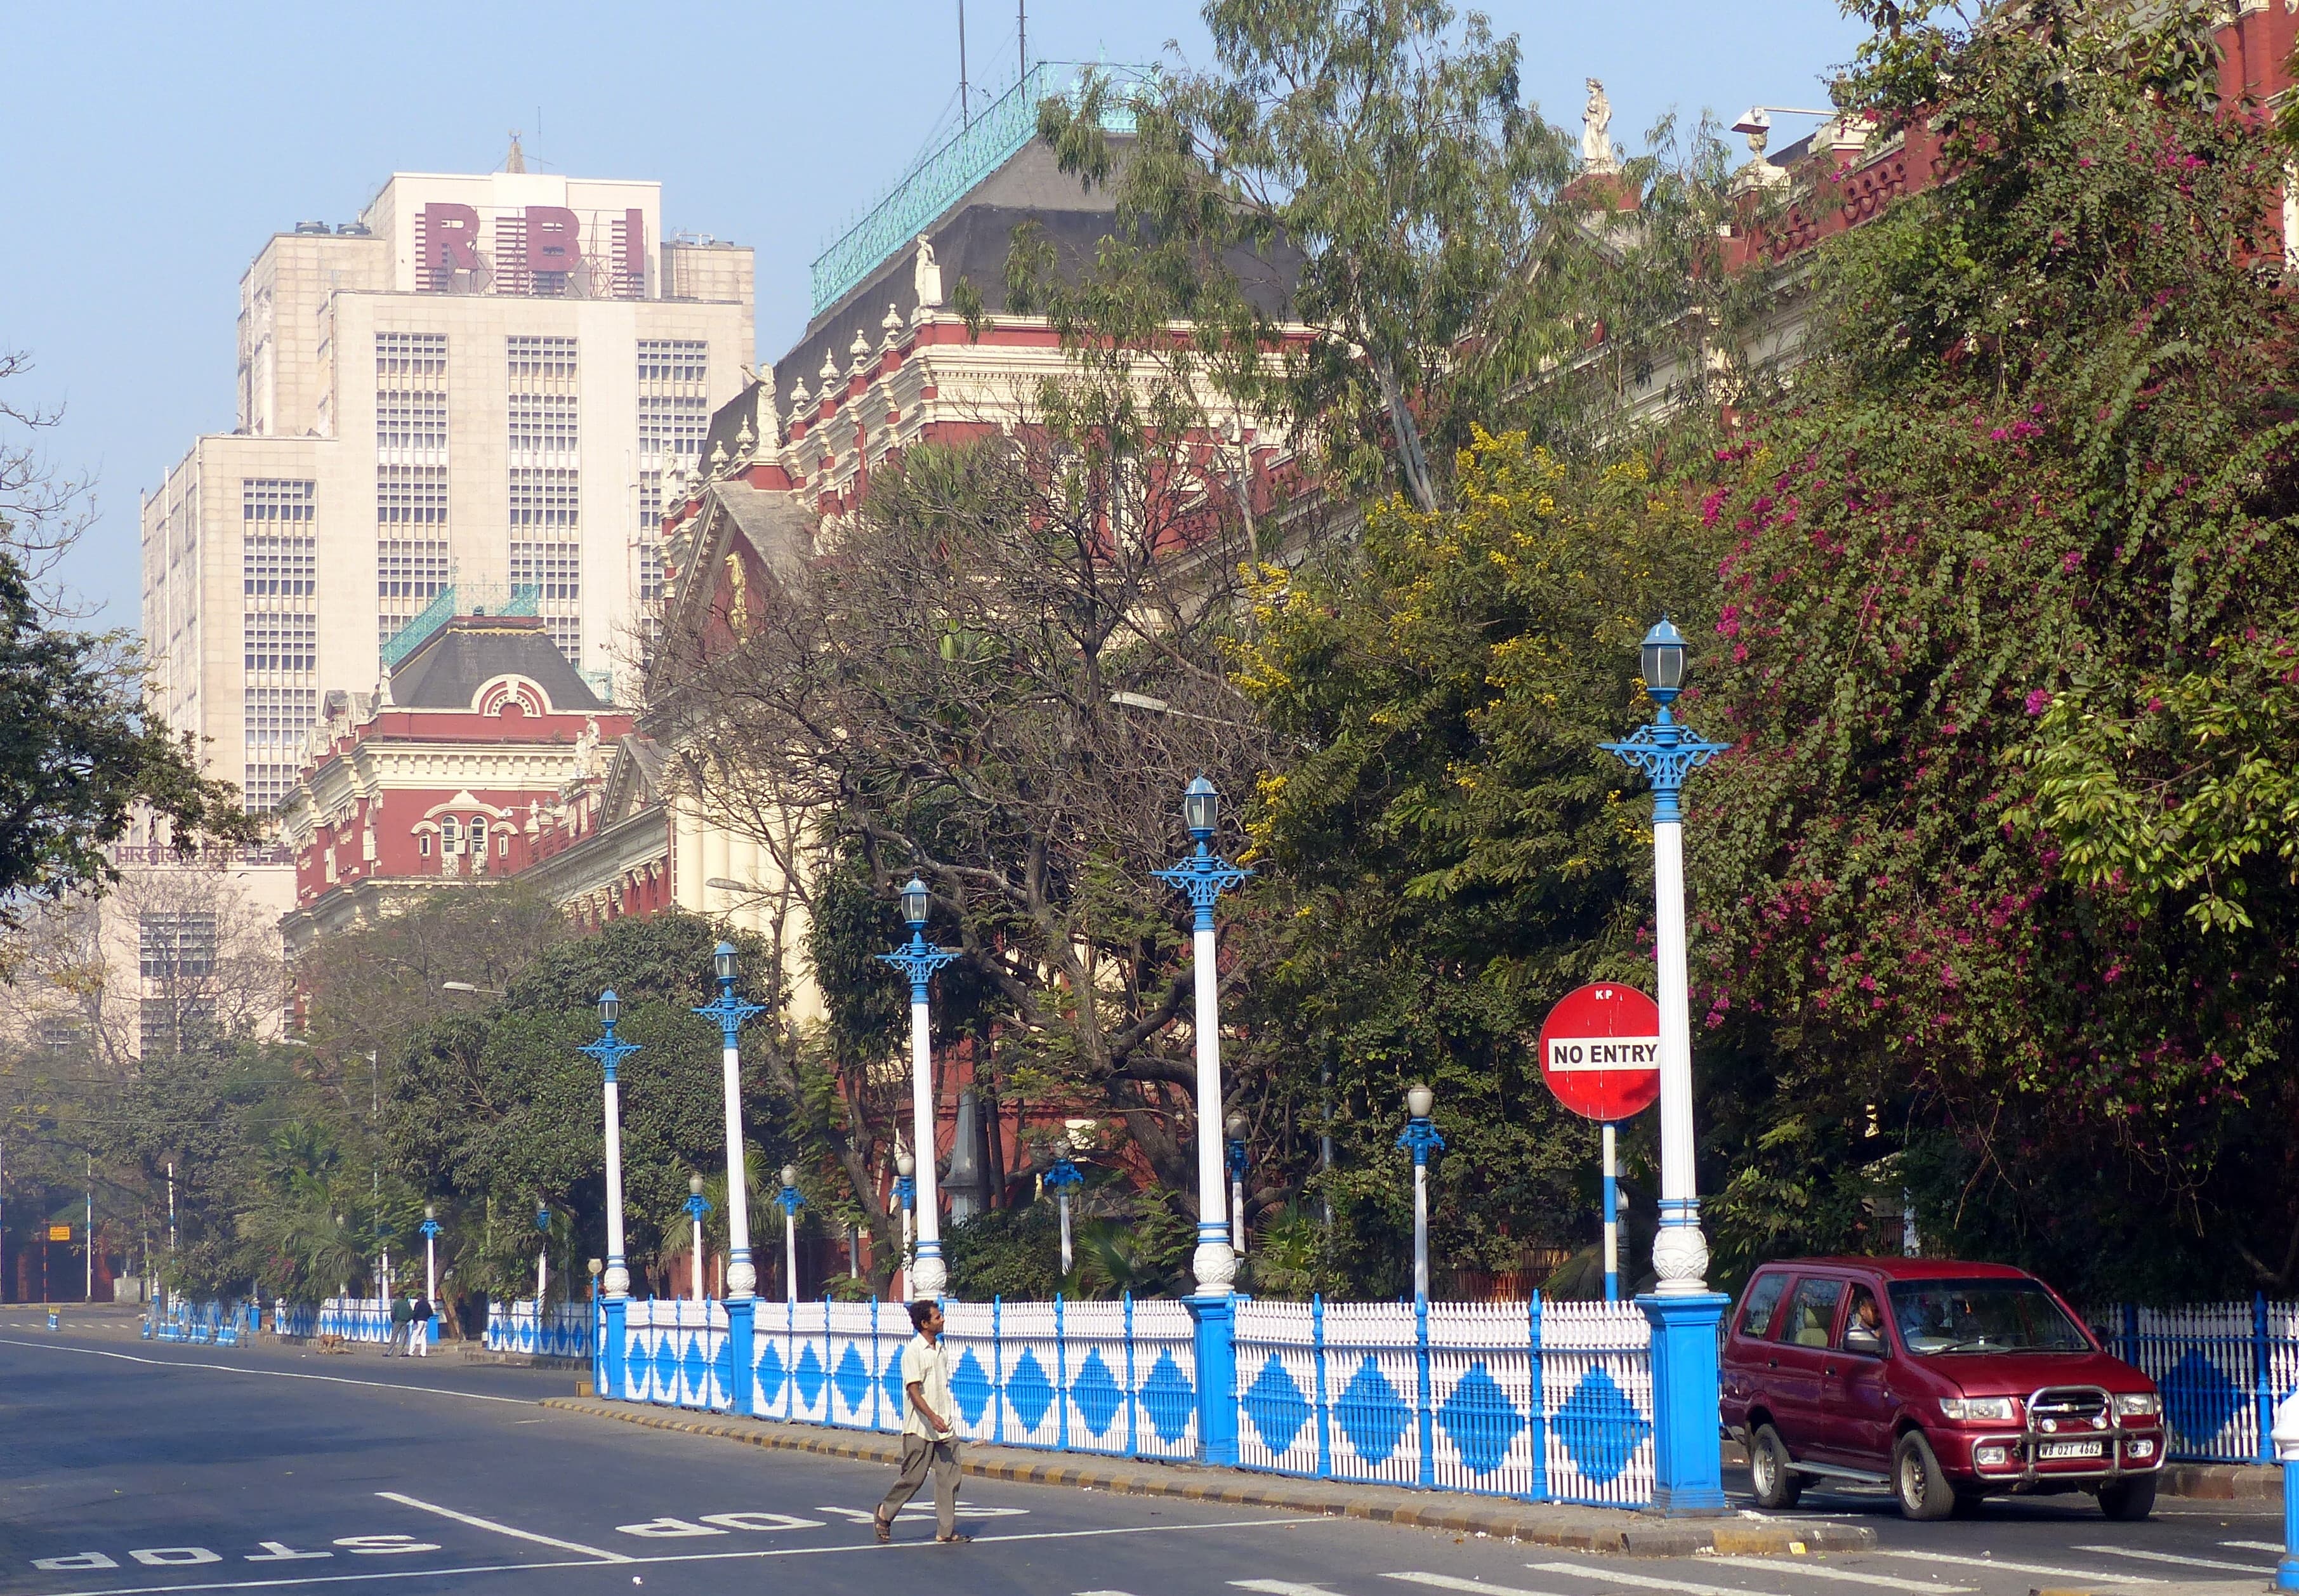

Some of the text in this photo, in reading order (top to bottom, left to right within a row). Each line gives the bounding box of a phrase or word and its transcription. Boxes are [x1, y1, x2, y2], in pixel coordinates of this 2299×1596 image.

[425, 202, 644, 274] RBI
[1595, 990, 1613, 1000] KP
[1554, 1043, 1659, 1064] NO ENTRY
[2041, 1445, 2053, 1456] WB
[2079, 1444, 2100, 1454] 4662
[29, 1534, 442, 1571] STOP
